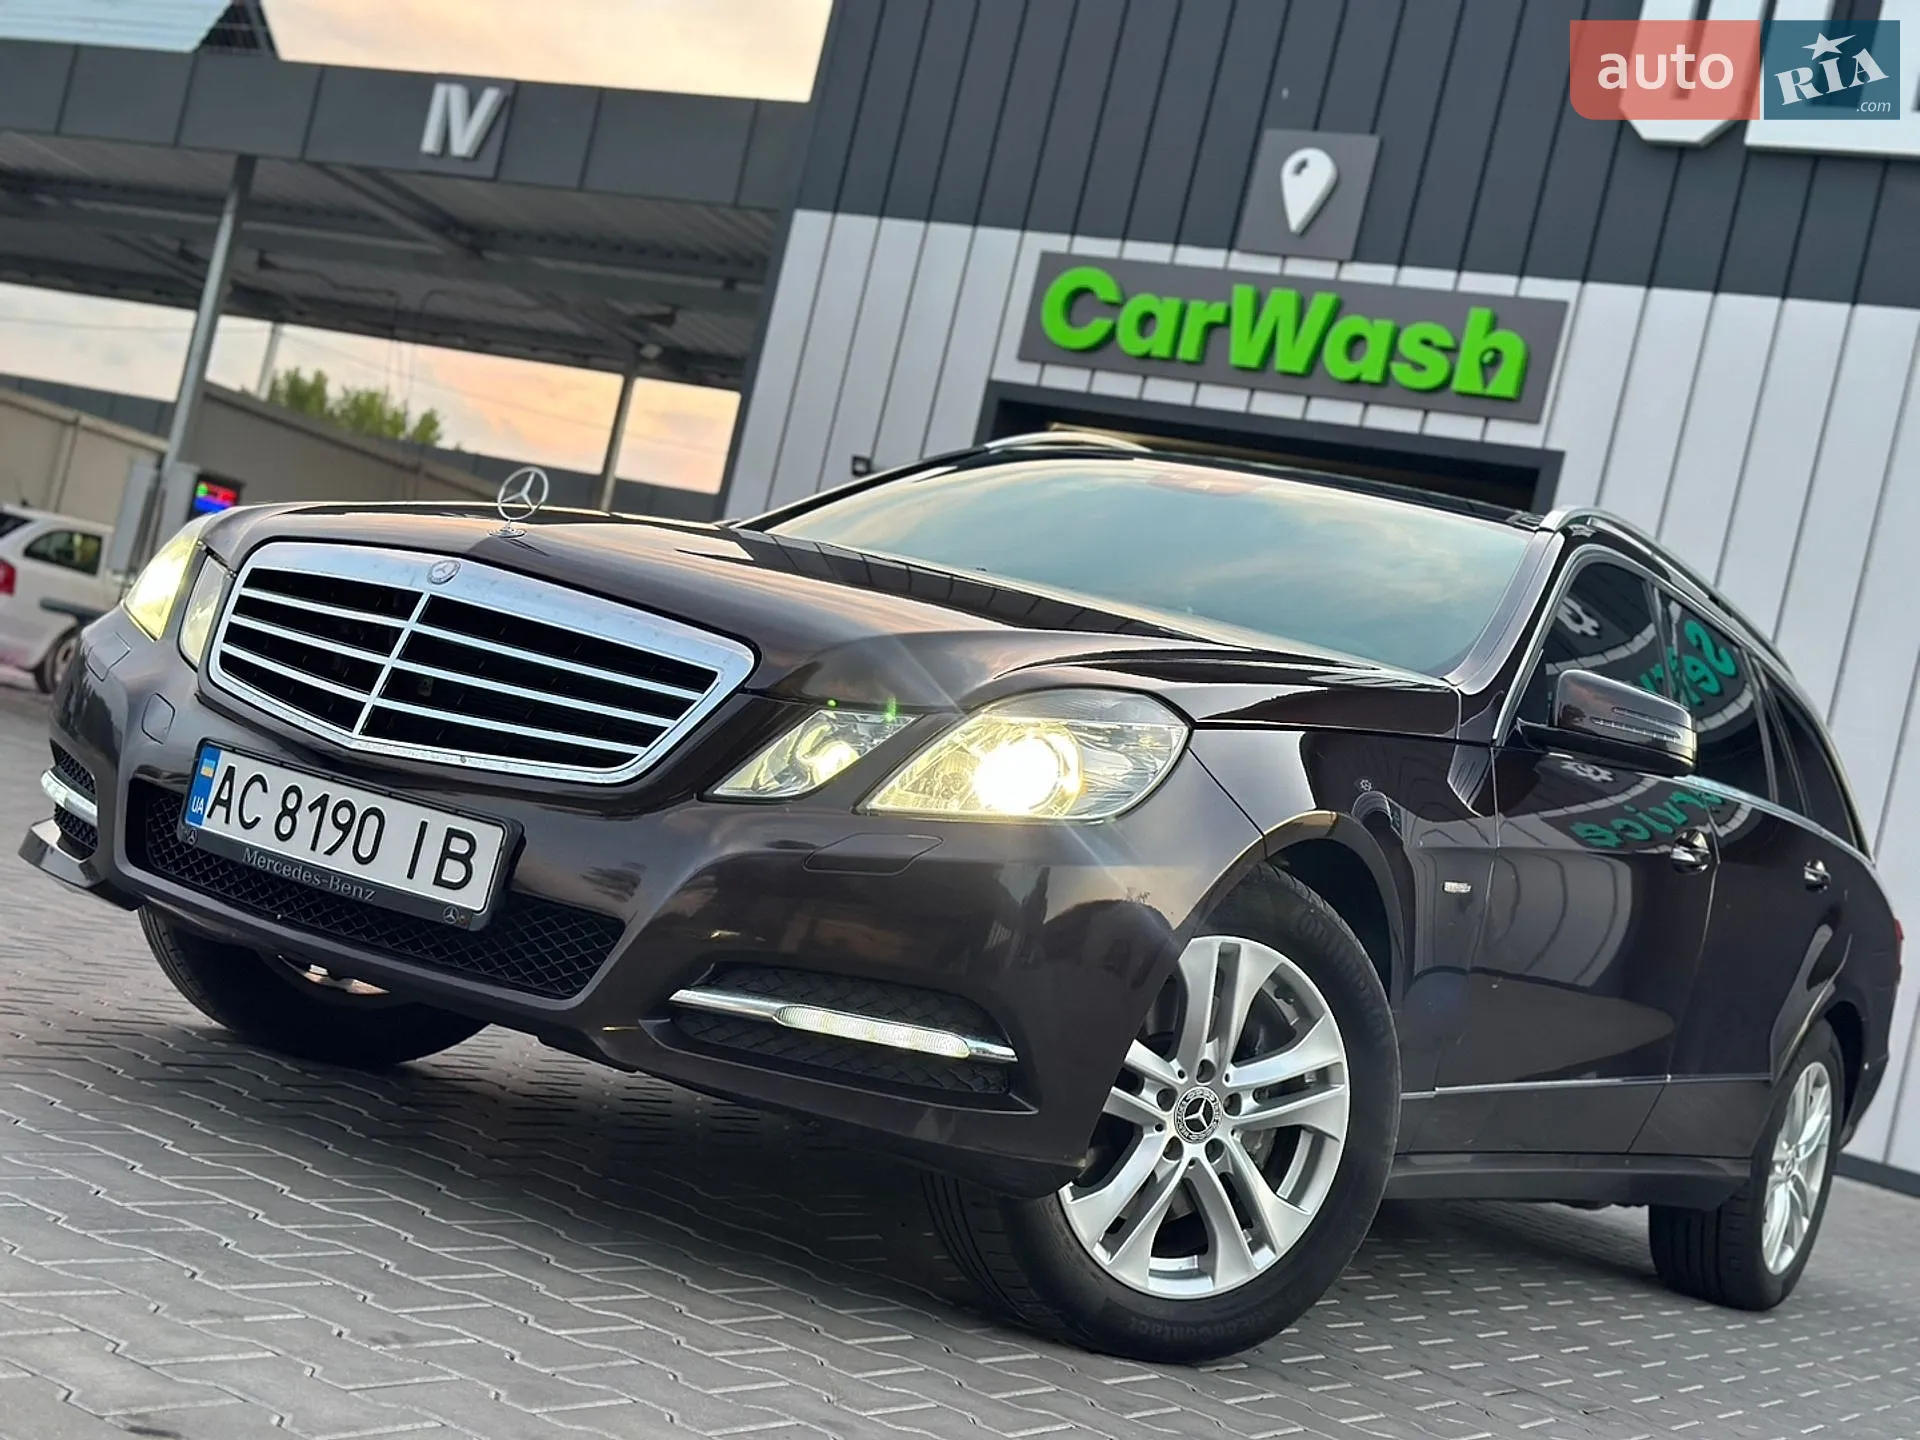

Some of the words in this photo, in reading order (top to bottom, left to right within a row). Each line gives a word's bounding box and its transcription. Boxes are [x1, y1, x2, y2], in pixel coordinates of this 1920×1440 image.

[1041, 266, 1529, 400] CarWash
[191, 796, 205, 815] UA
[206, 765, 269, 830] AC
[273, 784, 386, 866] 8190
[406, 820, 478, 891] IB
[241, 847, 377, 902] Mercedes-Benz
